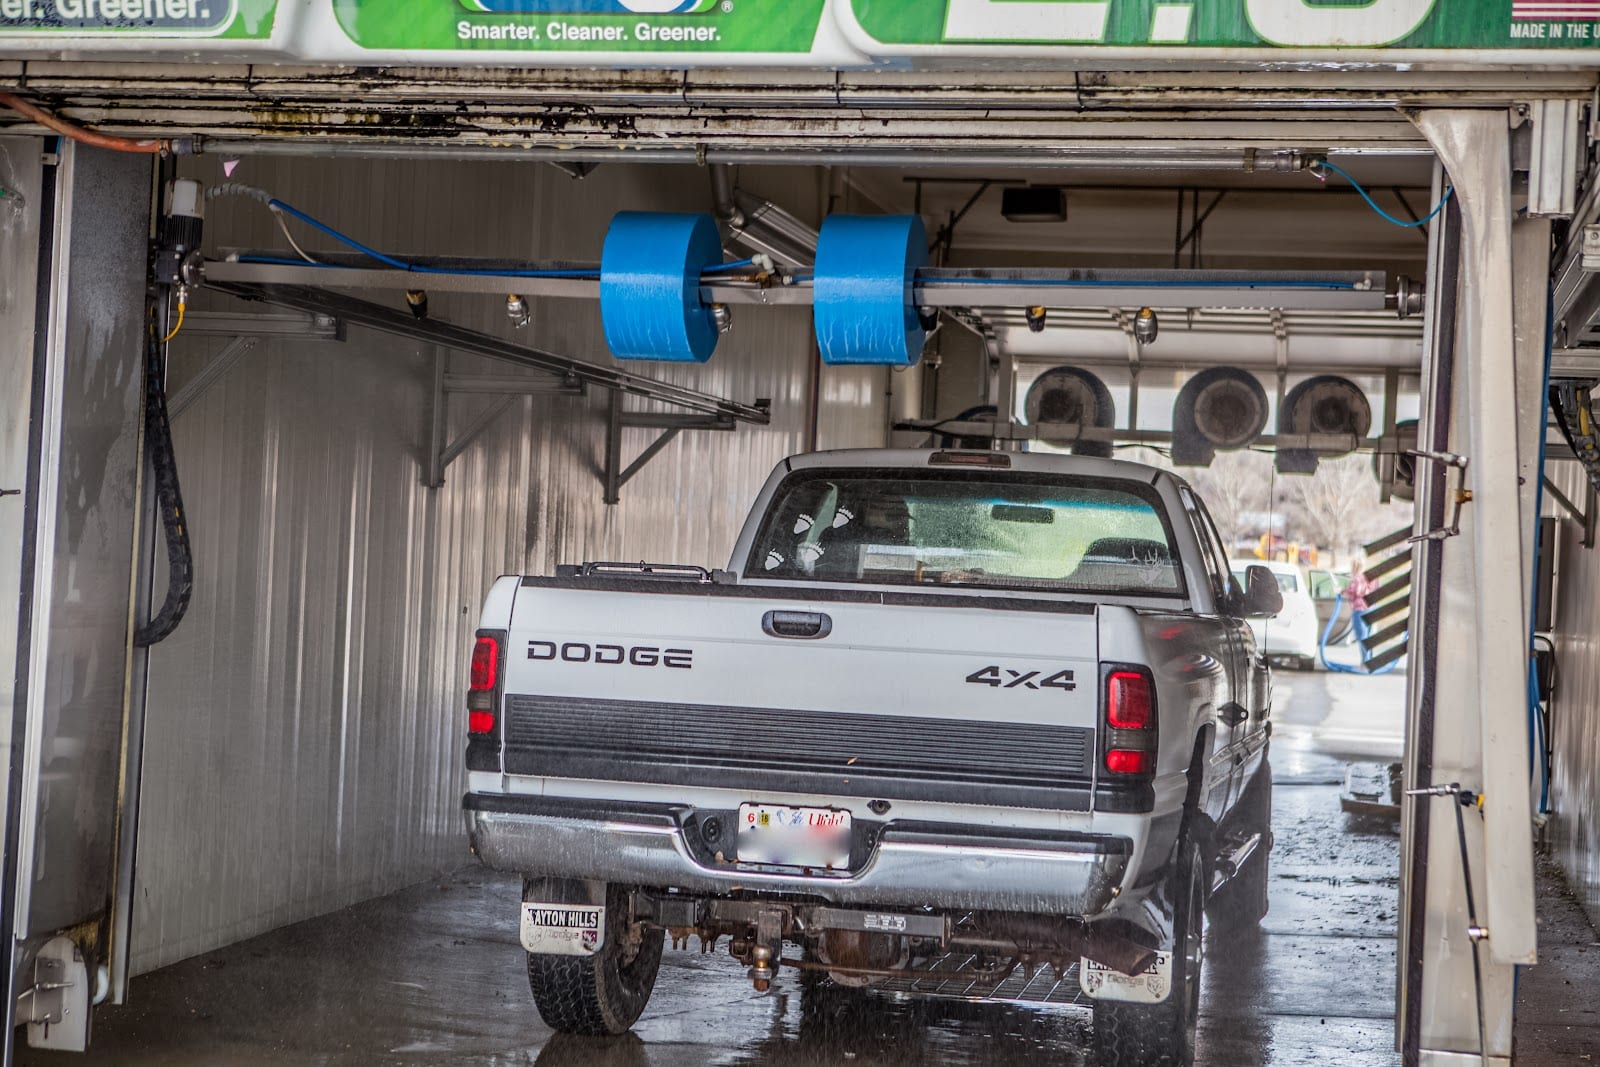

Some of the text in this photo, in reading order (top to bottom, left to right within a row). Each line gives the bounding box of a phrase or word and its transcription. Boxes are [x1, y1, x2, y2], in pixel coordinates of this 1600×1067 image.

[0, 0, 210, 19] er. Greener.
[457, 21, 721, 41] Smarter. Cleaner. Greener.
[1510, 23, 1546, 38] MADE
[1549, 23, 1562, 38] IN
[1567, 23, 1590, 38] THE
[527, 640, 693, 669] DODGE
[747, 813, 755, 823] 6
[568, 911, 597, 927] HILLS
